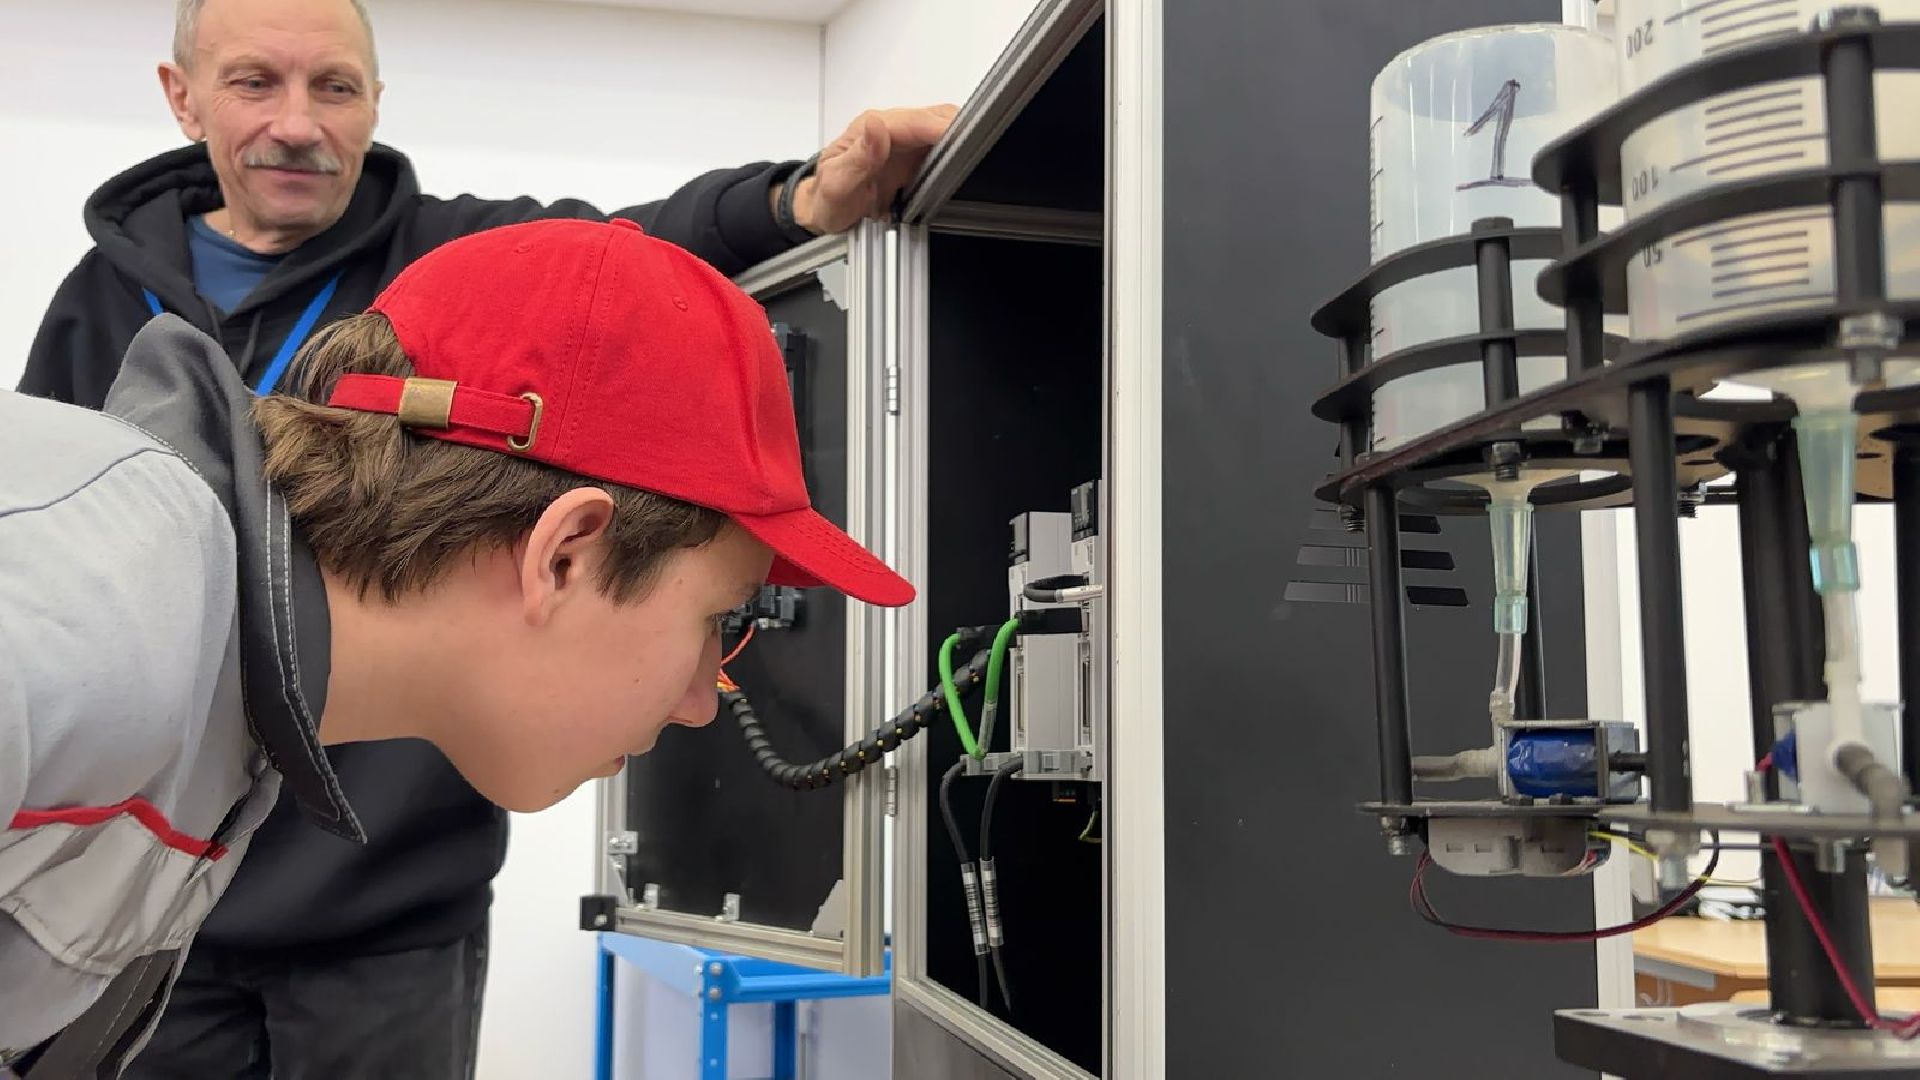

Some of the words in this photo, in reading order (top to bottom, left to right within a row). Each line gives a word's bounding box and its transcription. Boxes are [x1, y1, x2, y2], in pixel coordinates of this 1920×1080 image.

[1625, 19, 1653, 60] 200
[1456, 79, 1537, 191] 1
[1632, 166, 1659, 201] 100
[1643, 241, 1663, 268] 50
